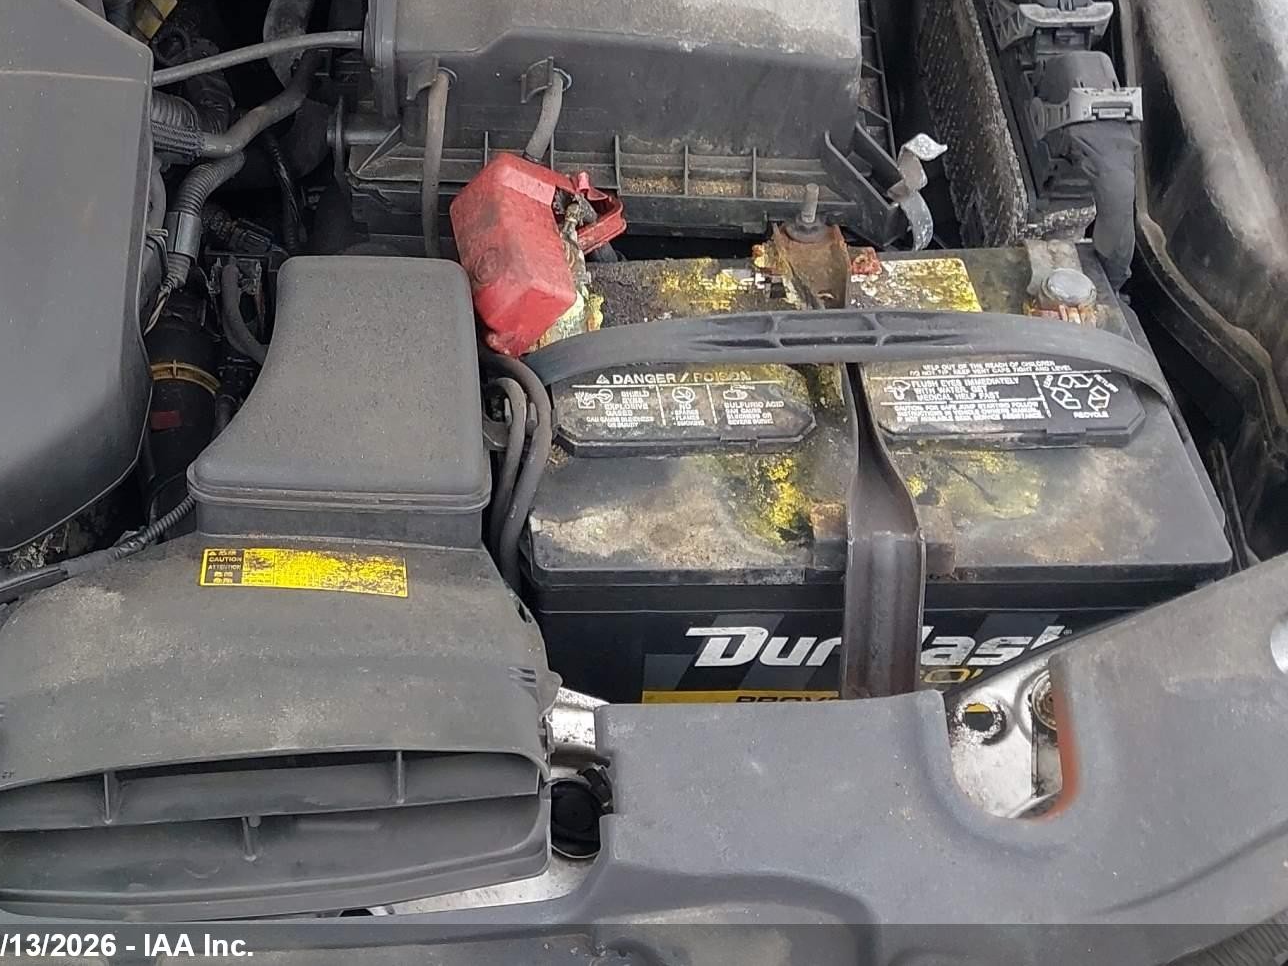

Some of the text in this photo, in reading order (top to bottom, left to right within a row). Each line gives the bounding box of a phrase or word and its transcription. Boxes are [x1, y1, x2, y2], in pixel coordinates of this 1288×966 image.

[613, 373, 677, 385] DANGER
[693, 369, 752, 382] POISON
[911, 376, 1019, 388] FLUSH EYES IMMEDIATELY
[765, 400, 785, 408] ACID
[208, 555, 243, 563] CAUTION
